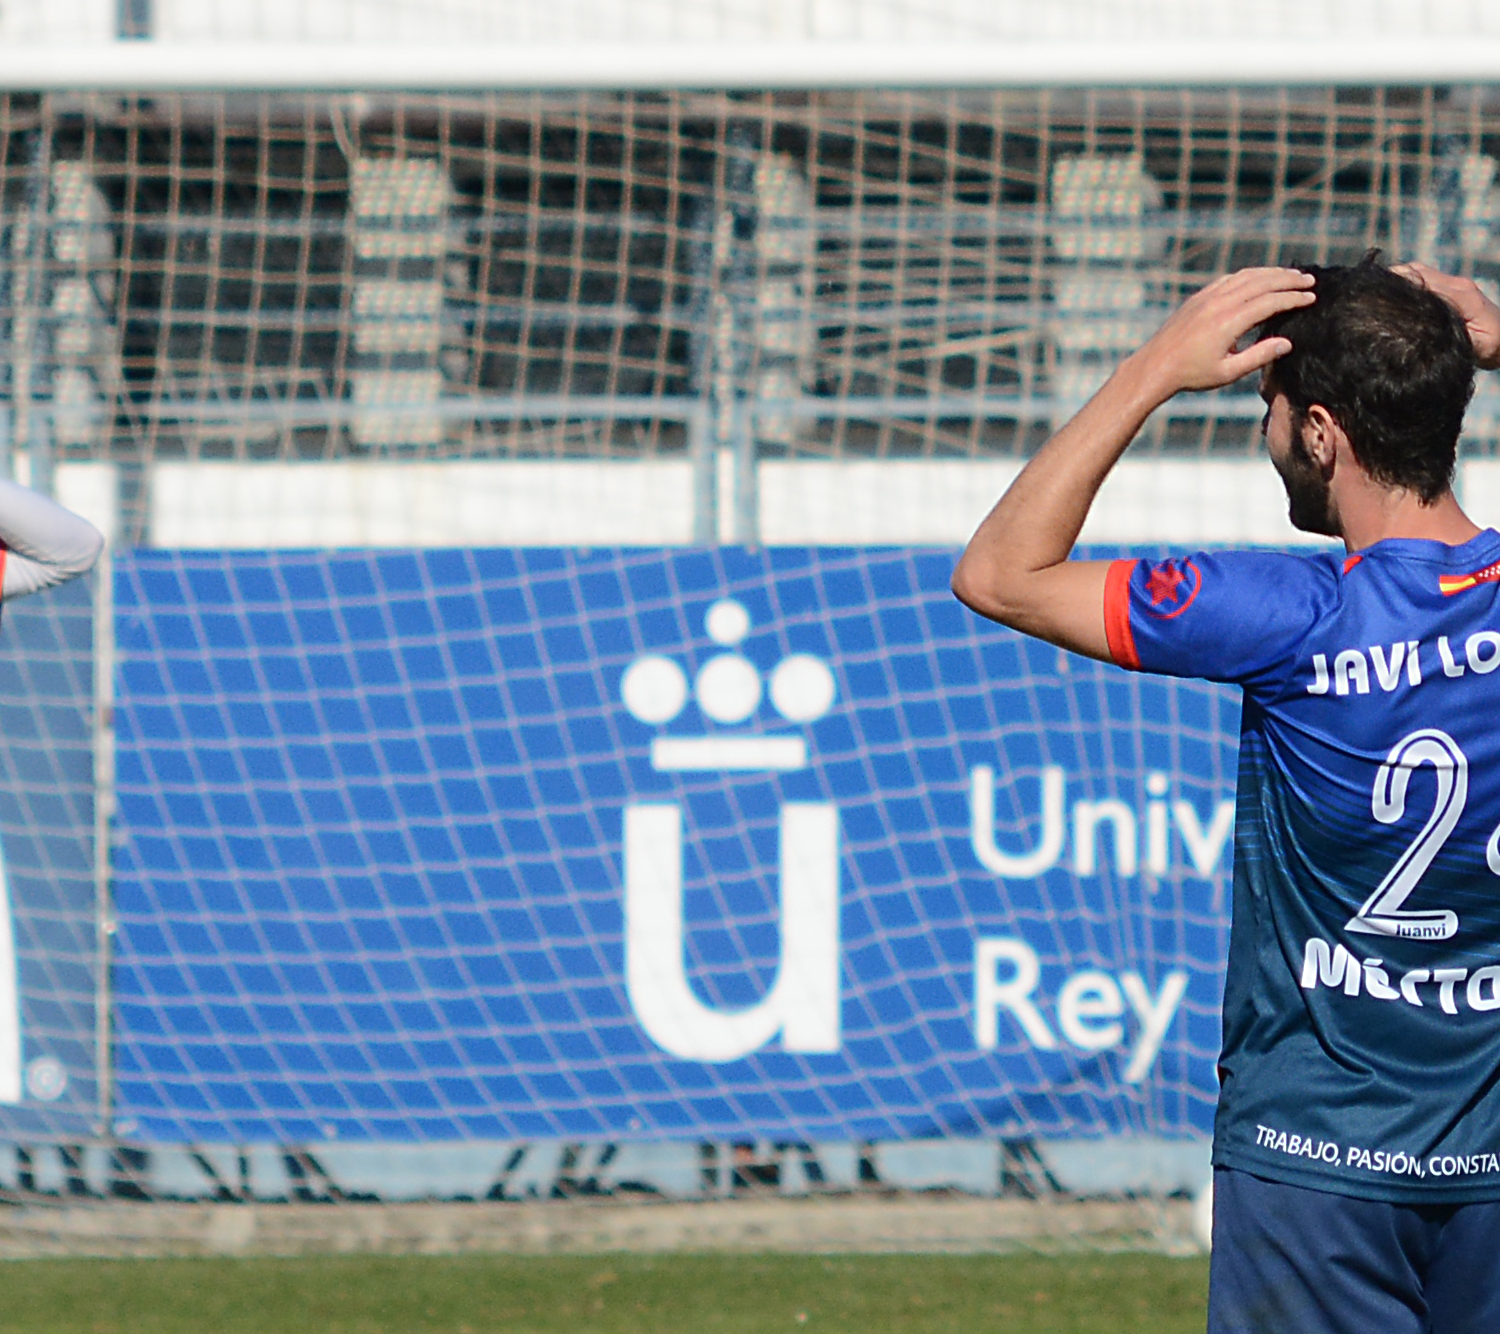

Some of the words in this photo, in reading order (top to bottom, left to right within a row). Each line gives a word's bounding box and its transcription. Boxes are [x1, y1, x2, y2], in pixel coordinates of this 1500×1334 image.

[1307, 640, 1422, 696] JAVI
[973, 937, 1189, 1083] Rey
[1256, 1124, 1342, 1167] TRABAJO,
[1346, 1146, 1426, 1179] PASIÓN,
